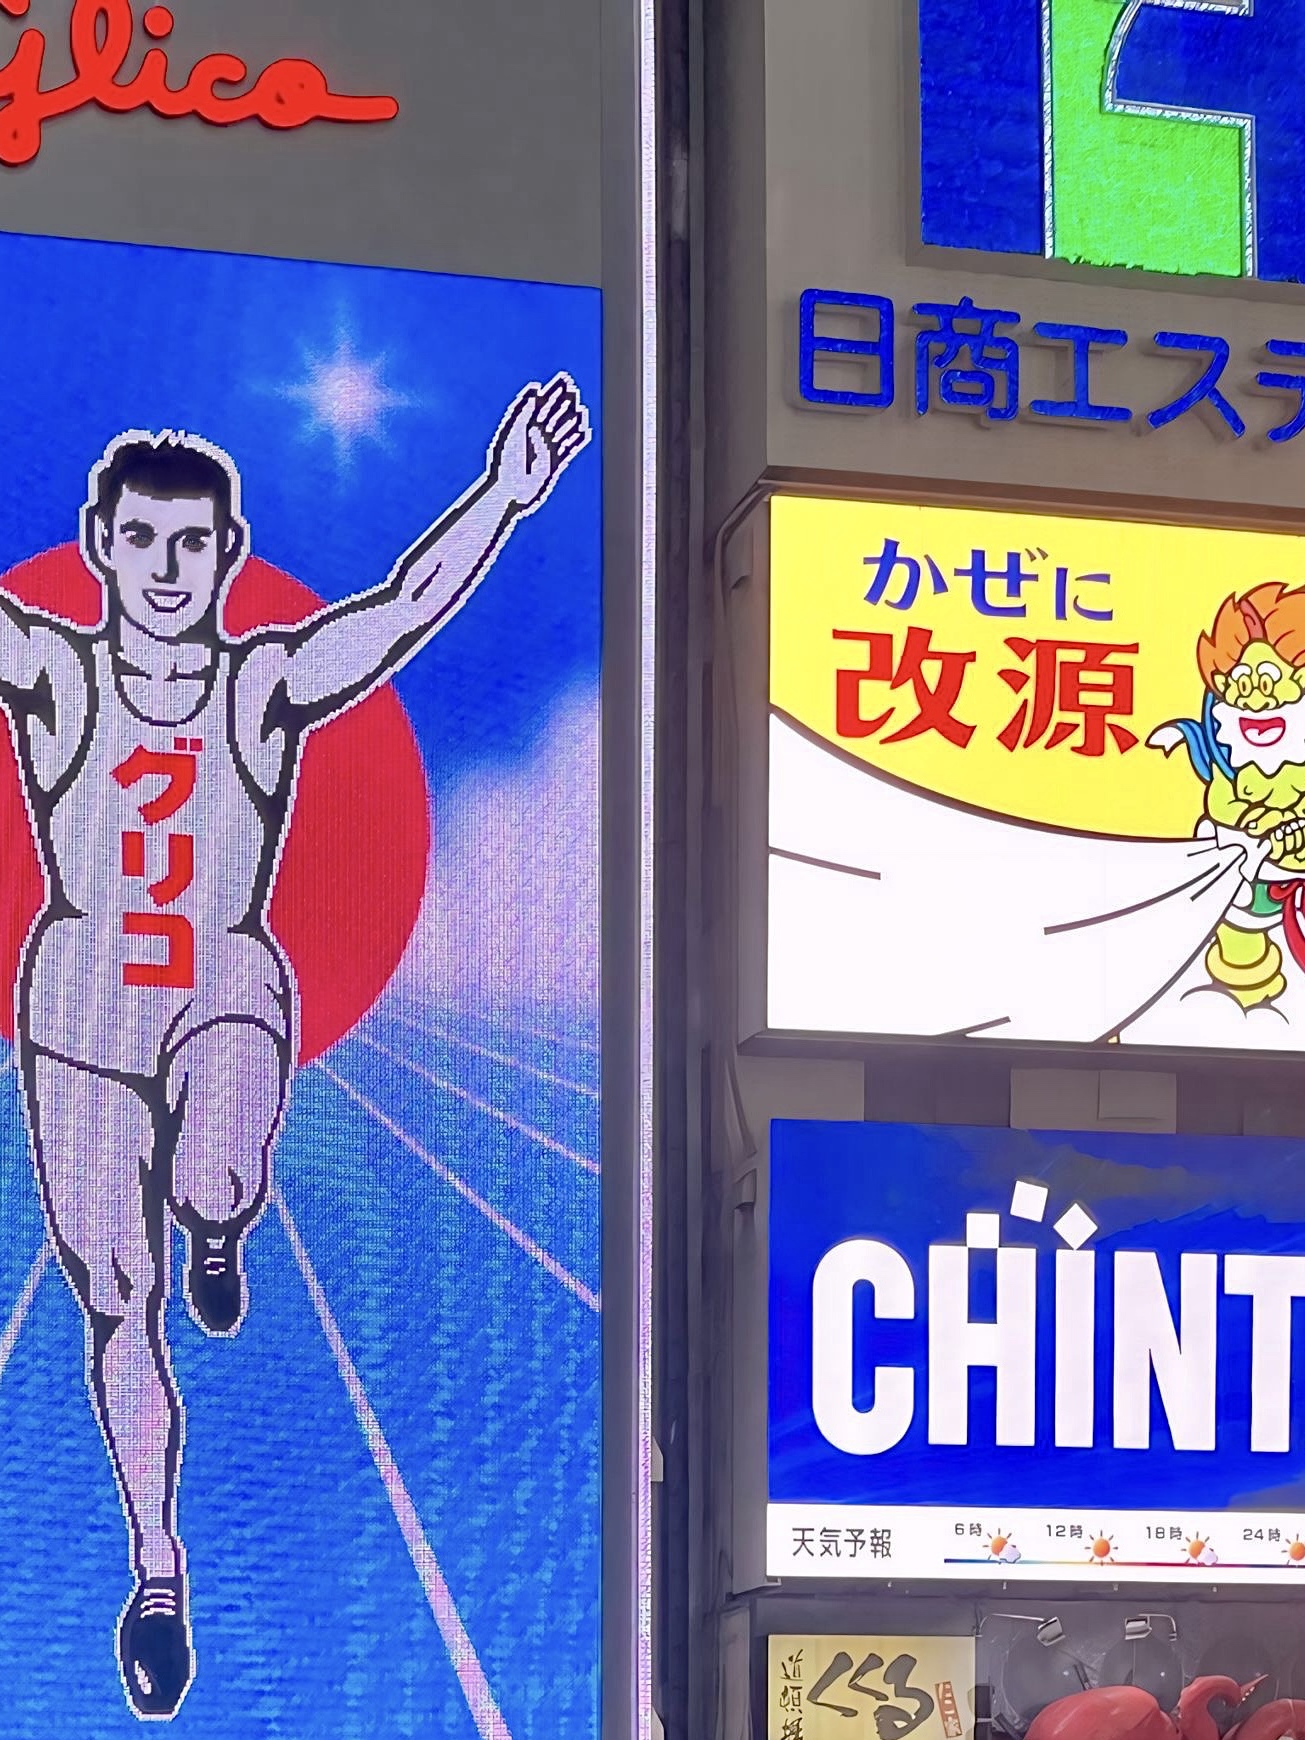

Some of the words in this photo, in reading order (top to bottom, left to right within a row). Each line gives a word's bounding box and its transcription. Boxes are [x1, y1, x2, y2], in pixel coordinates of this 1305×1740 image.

[862, 538, 1114, 622] かぜに
[832, 626, 1140, 758] 改源
[110, 737, 203, 988] グリコ
[792, 1526, 893, 1559] 天気予報
[954, 1523, 983, 1538] 6時
[1046, 1525, 1084, 1540] 12時
[1145, 1526, 1183, 1541] 18時
[1243, 1527, 1282, 1542] 24時
